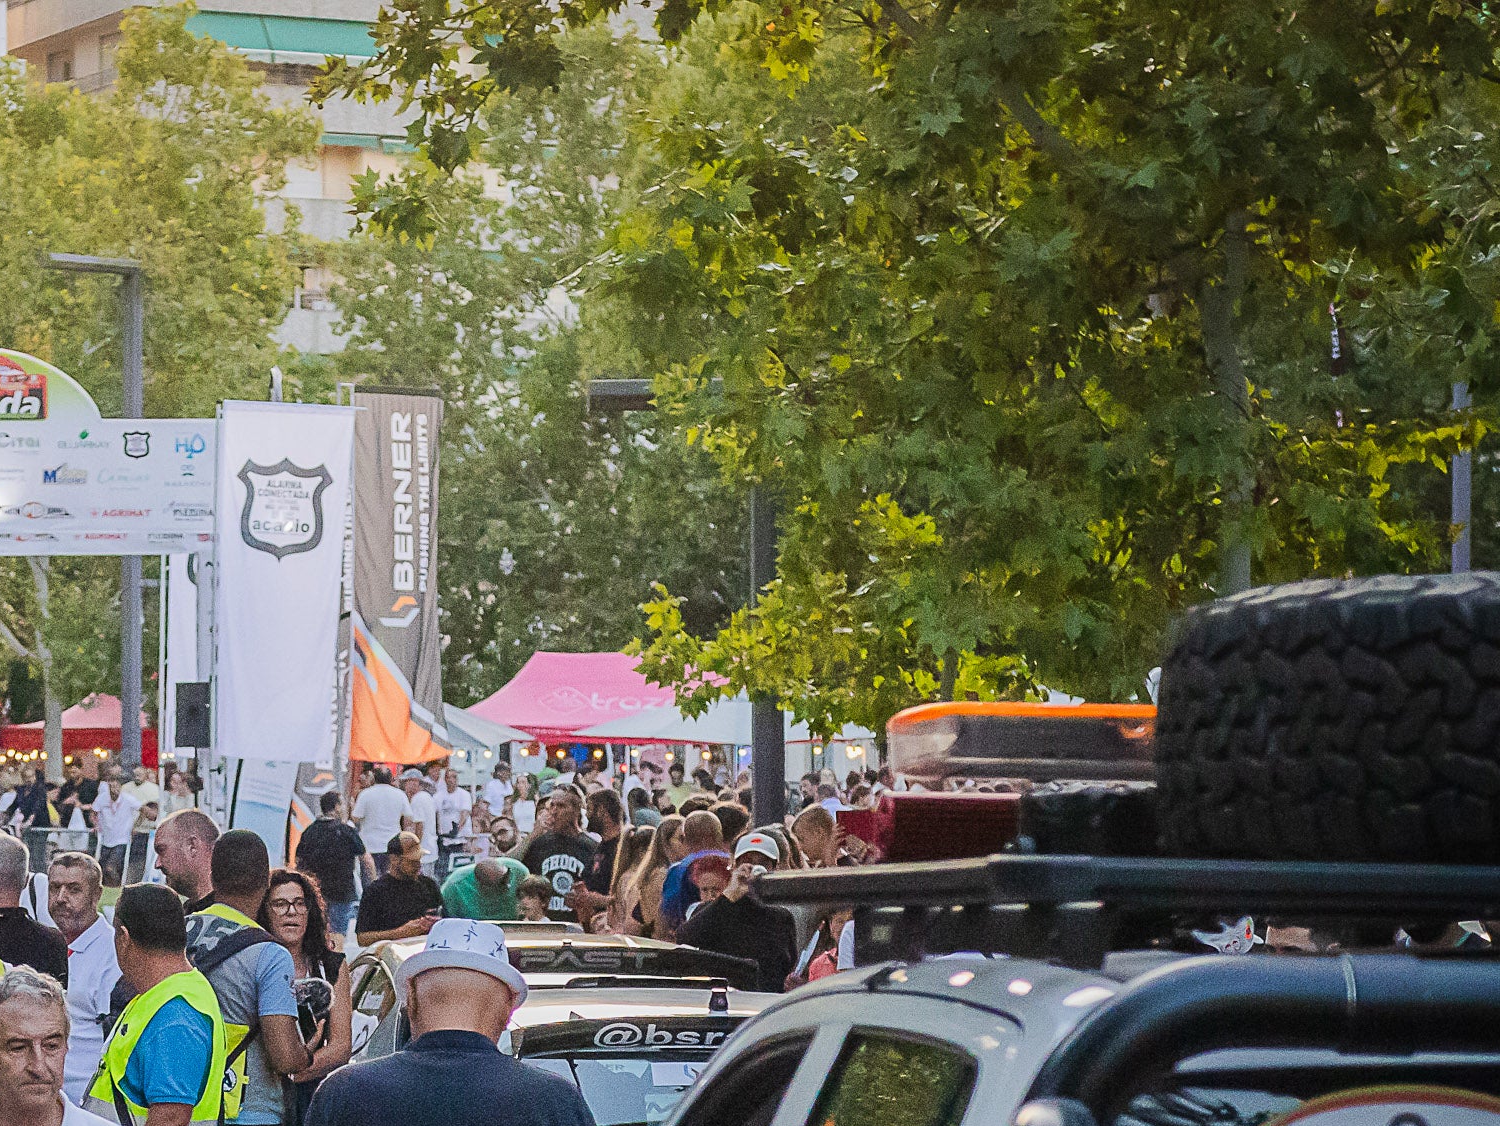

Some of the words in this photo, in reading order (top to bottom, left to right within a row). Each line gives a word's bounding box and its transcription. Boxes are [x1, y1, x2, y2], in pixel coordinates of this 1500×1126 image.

[415, 413, 430, 473] LIMITS
[390, 411, 415, 591] BERNER
[418, 475, 430, 511] THE
[418, 513, 430, 593] PUSHING
[593, 1022, 731, 1049] @bsr
